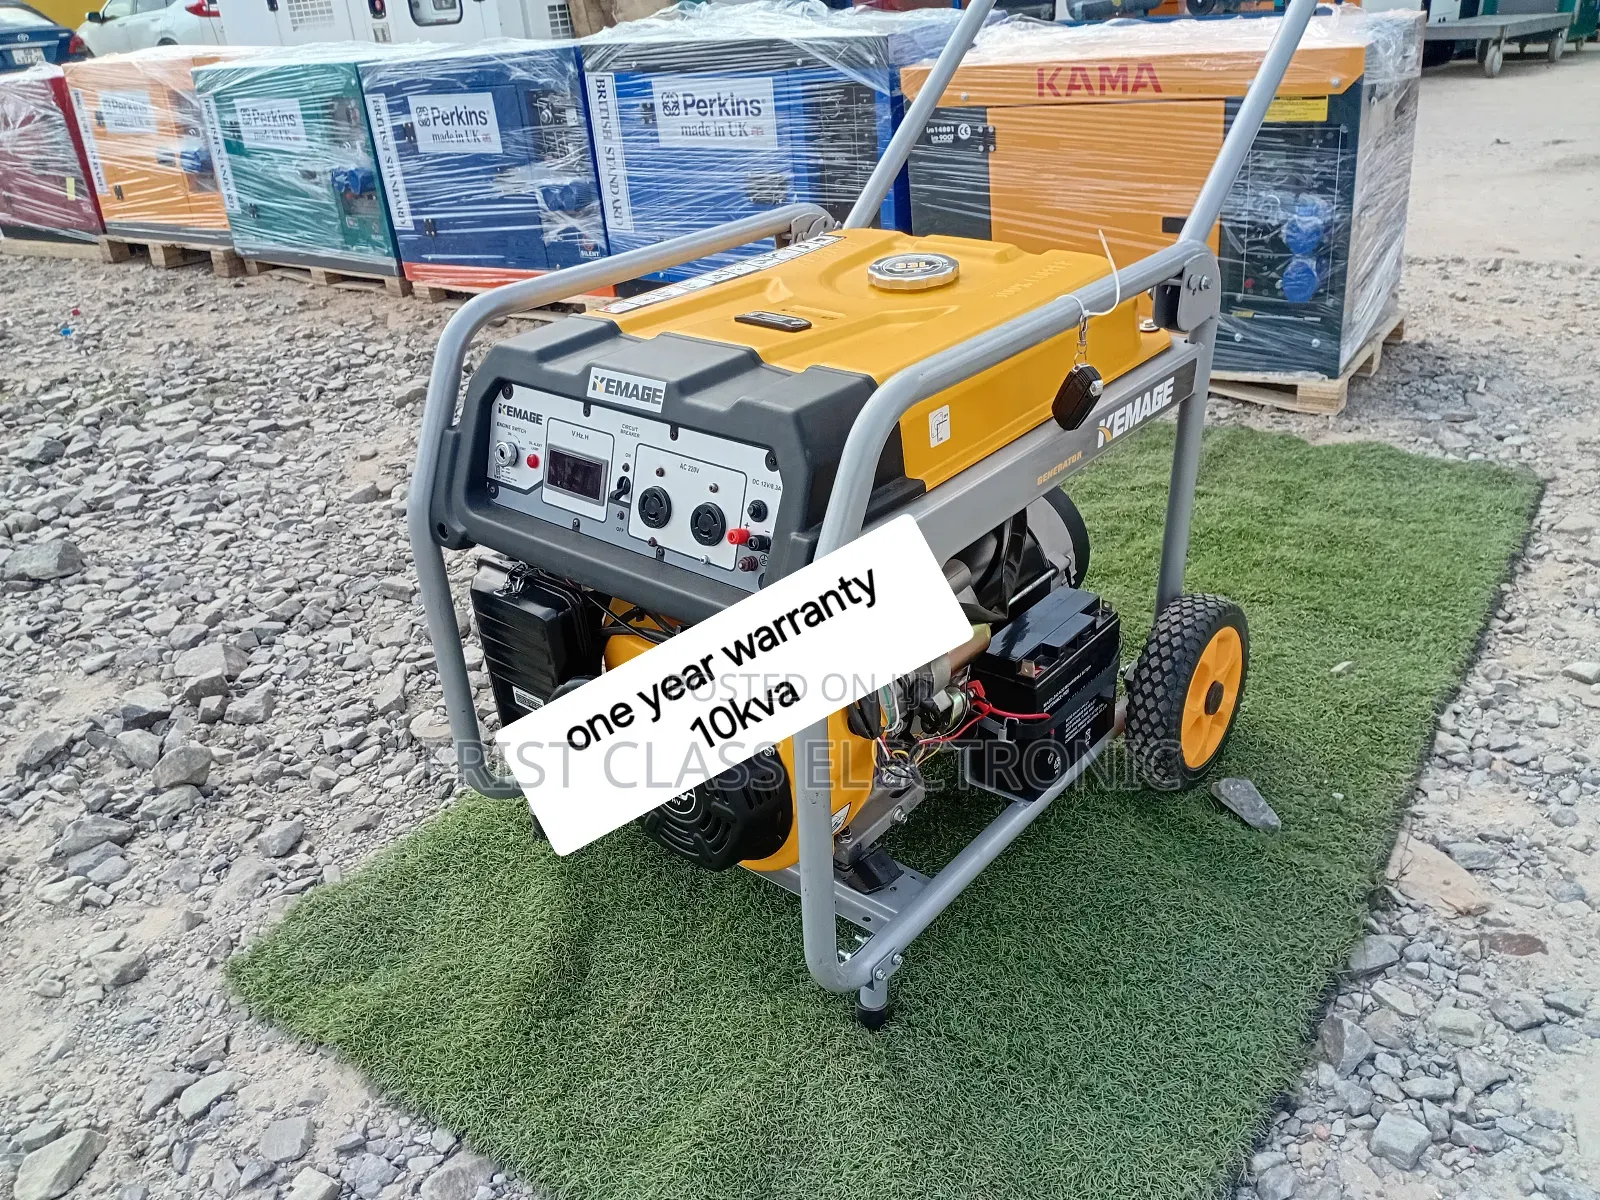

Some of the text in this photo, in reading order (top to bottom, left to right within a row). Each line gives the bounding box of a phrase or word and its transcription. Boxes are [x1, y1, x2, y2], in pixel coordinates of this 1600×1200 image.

[1036, 62, 1162, 98] KAMA
[682, 92, 763, 117] Perkins
[251, 108, 297, 127] Perkins
[430, 105, 488, 127] Perkins
[432, 129, 482, 143] made in UK
[681, 122, 750, 137] made in UK
[596, 79, 623, 226] BRITISH STANDARD
[592, 375, 663, 405] KEMAGE
[498, 403, 543, 425] KEMAGE
[1097, 376, 1175, 448] KEMAGE
[621, 423, 639, 432] CIRCUIT
[680, 463, 700, 474] AC 220V
[1037, 451, 1083, 486] GENERATOR
[752, 478, 760, 486] DC
